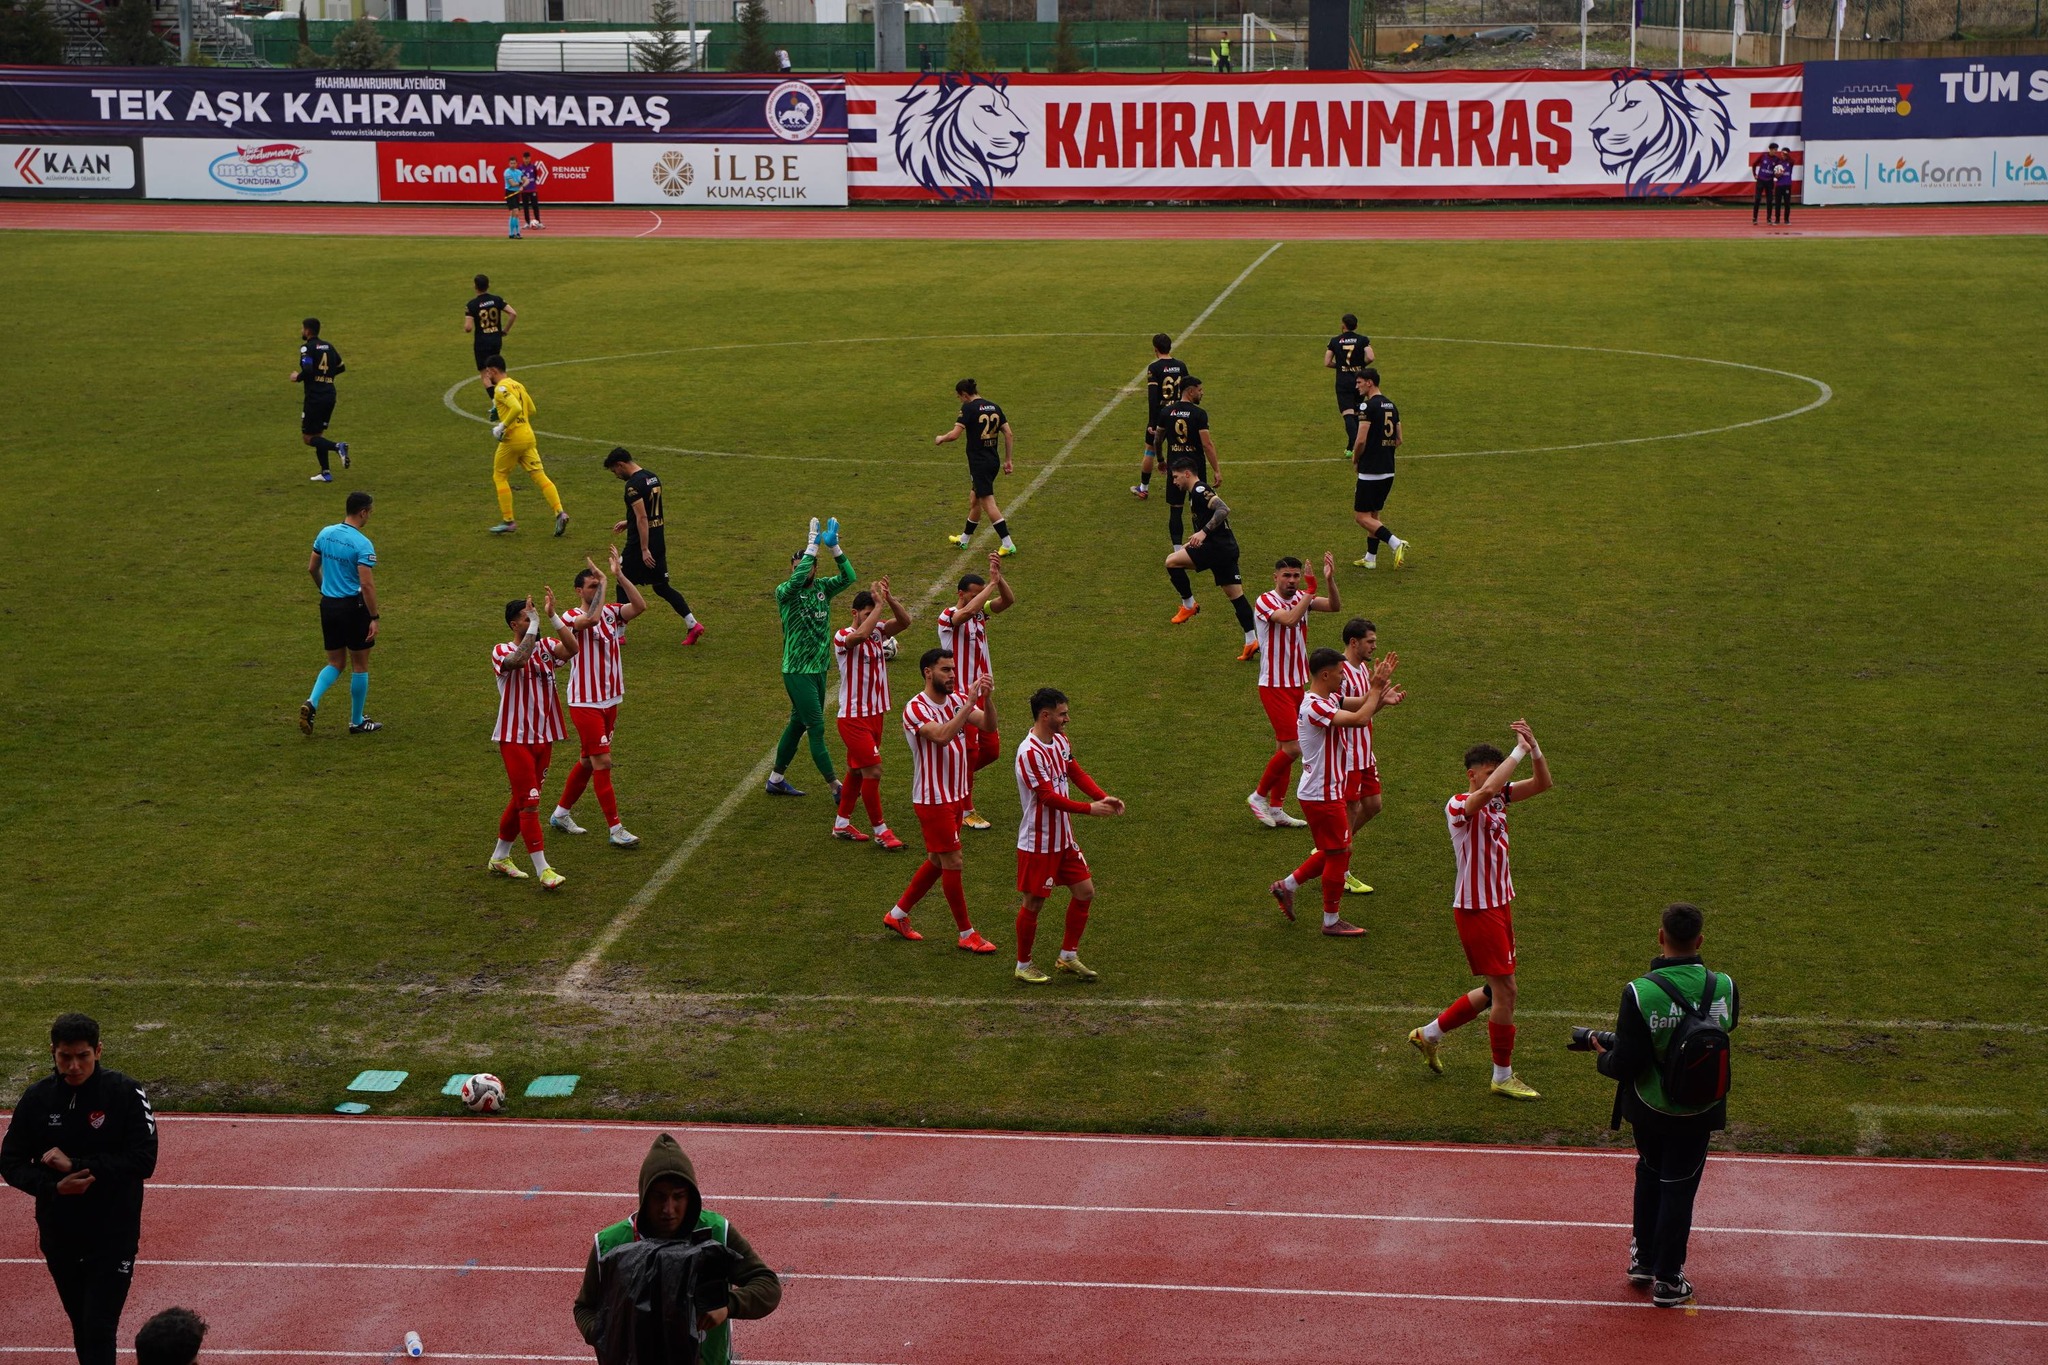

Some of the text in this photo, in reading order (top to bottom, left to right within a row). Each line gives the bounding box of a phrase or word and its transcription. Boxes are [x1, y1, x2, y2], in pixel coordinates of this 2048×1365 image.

[315, 76, 446, 90] #KAHRAMANRUHUNLAYENİDEN
[1940, 64, 2019, 103] TÜM
[91, 89, 670, 133] TEK AŞK KAHRAMANMARAŞ
[1832, 96, 1897, 105] Kahramanmaraş
[1832, 104, 1896, 115] Büyükşehir Belediyesi
[1045, 99, 1573, 173] KAHRAMANMARAŞ
[44, 152, 111, 174] KAAN
[217, 163, 297, 178] marasta
[396, 159, 498, 184] kemak
[714, 147, 800, 181] İLBE
[1814, 164, 1855, 184] tria
[2006, 160, 2048, 181] tria
[706, 186, 807, 202] KUMAŞÇILIK
[479, 307, 498, 327] 89
[318, 352, 328, 374] 4
[1342, 345, 1355, 365] 7
[1162, 376, 1181, 399] 61
[979, 413, 1000, 439] 22
[1174, 419, 1188, 443] 9
[1384, 412, 1394, 437] 5
